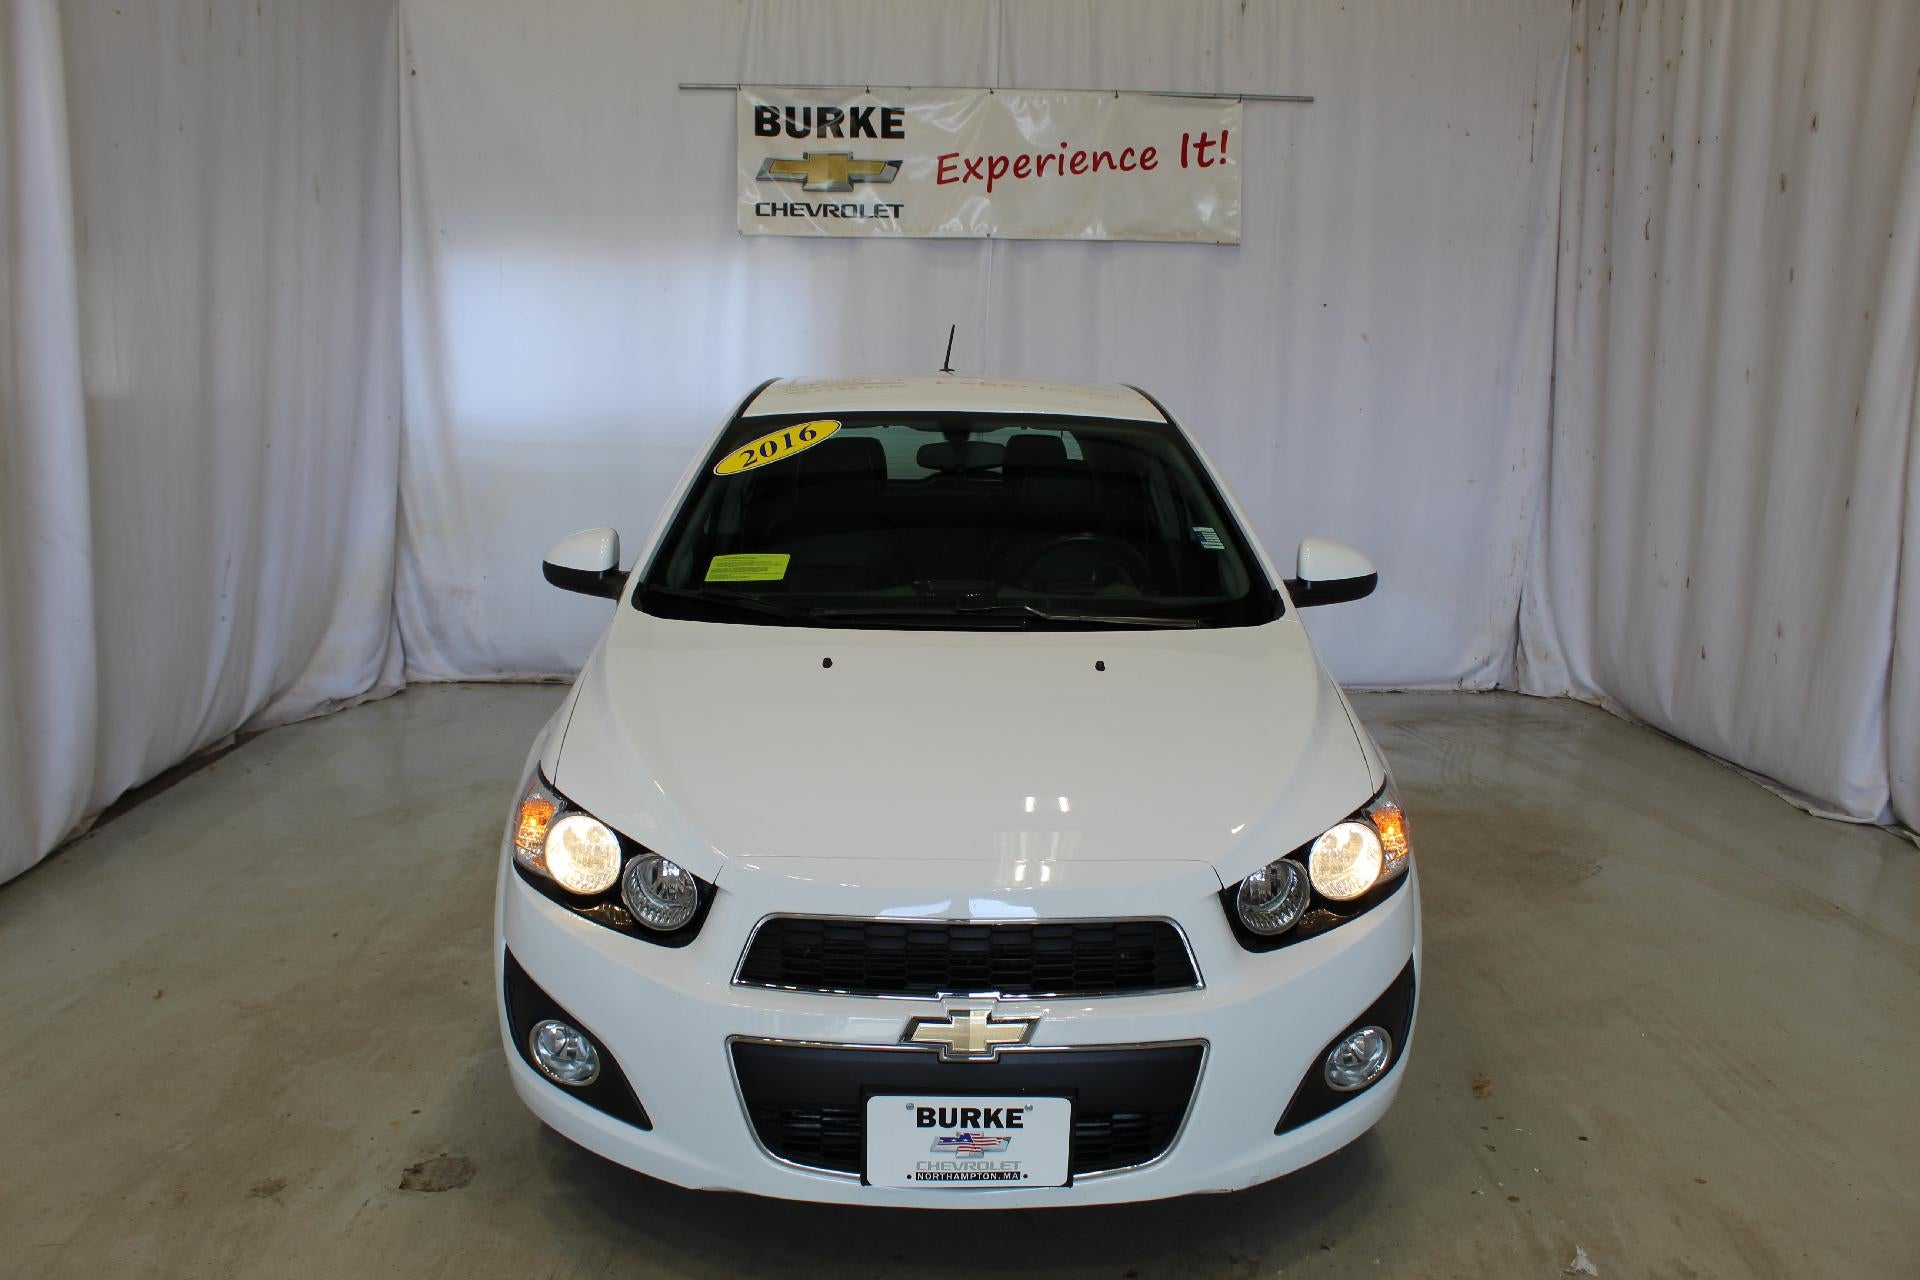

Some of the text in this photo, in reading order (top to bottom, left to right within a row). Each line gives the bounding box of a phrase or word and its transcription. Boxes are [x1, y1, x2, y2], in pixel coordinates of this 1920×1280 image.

[755, 106, 906, 139] BURKE
[936, 130, 1229, 193] Experience It!
[755, 202, 905, 219] CHEVROLET
[739, 423, 817, 468] 2016
[916, 1107, 1024, 1129] BURKE
[916, 1161, 1022, 1171] CHEVROLET
[1003, 1172, 1019, 1180] MA
